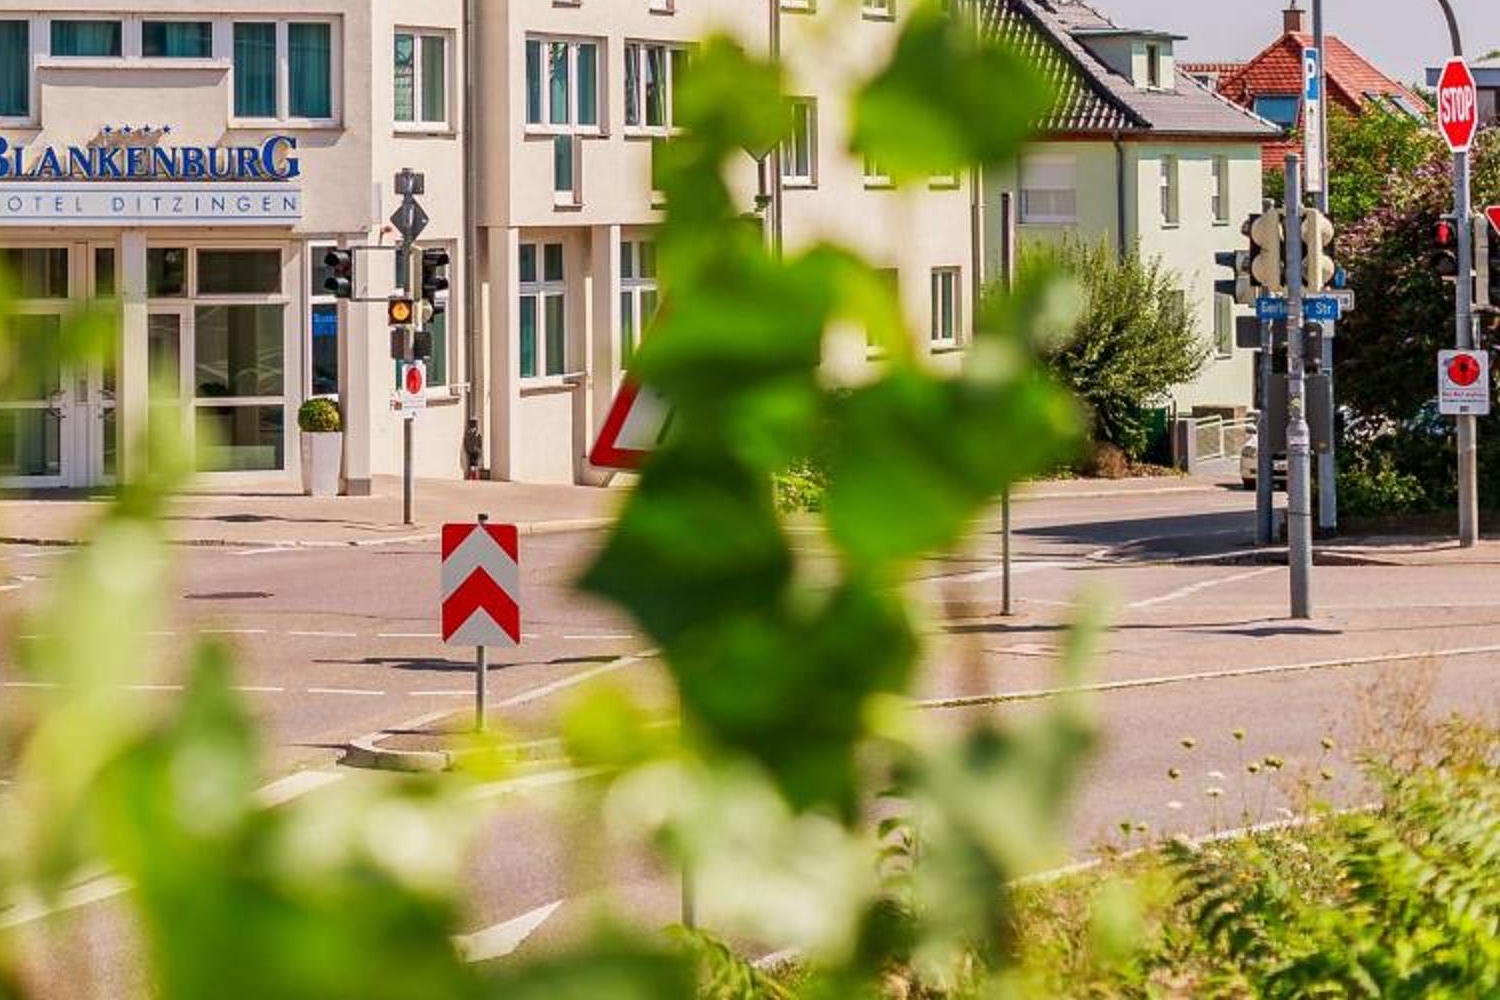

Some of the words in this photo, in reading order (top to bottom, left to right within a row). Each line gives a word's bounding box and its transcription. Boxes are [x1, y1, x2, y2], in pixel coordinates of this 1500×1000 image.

[1305, 58, 1316, 91] P
[1442, 87, 1473, 123] STOP
[112, 196, 297, 212] DITZINGEN
